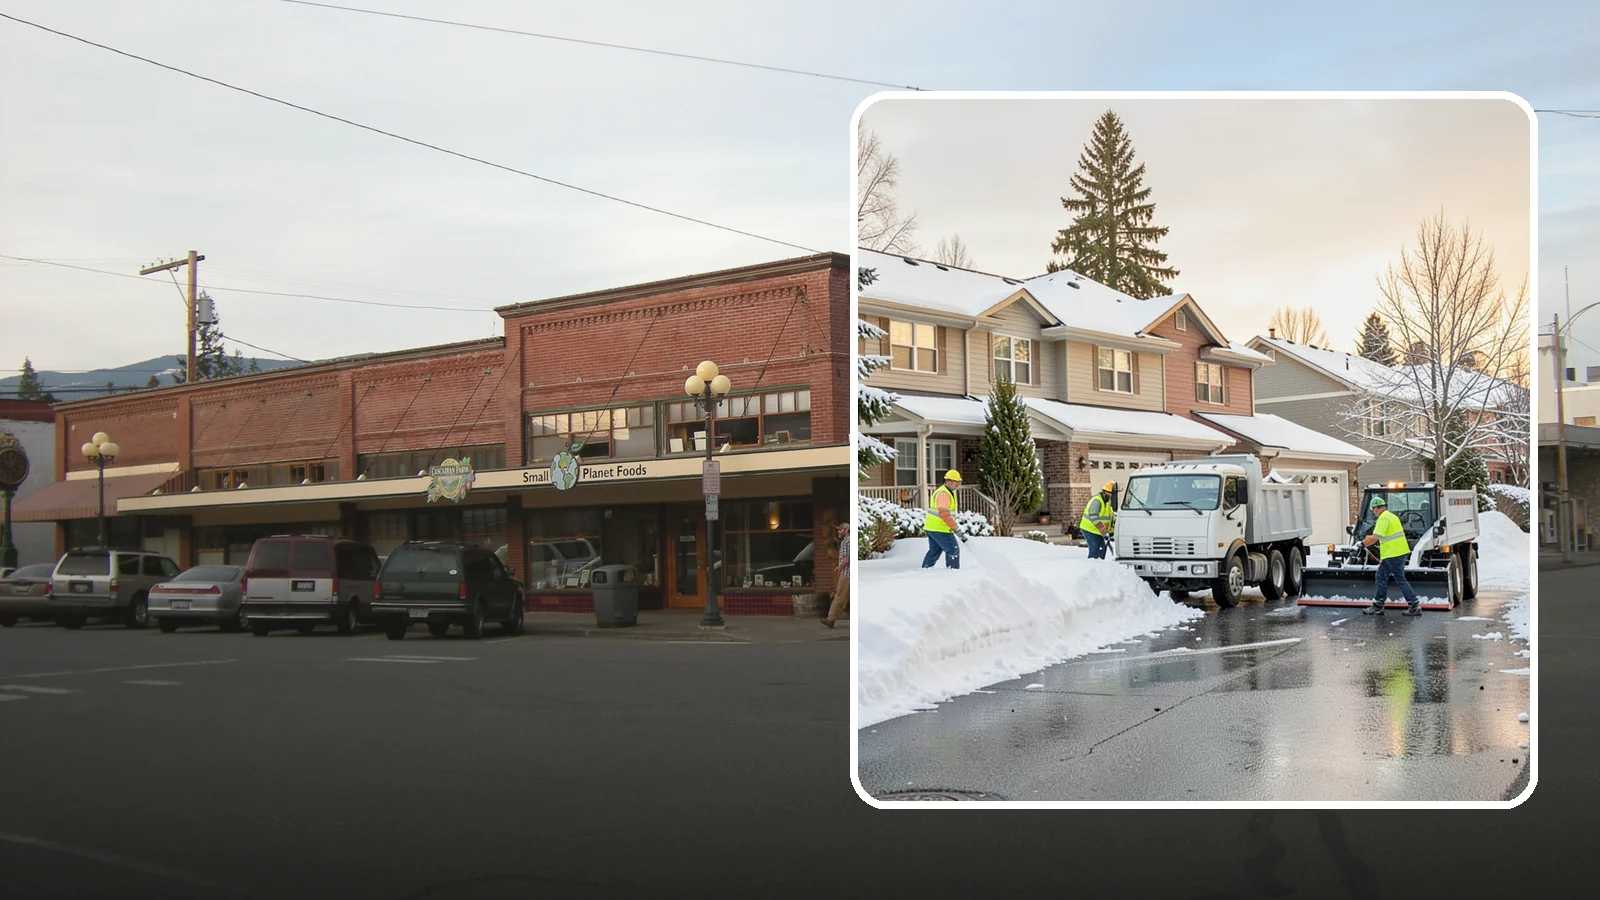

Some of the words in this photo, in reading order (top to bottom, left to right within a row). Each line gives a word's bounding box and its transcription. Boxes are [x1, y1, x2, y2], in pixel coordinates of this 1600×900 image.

[523, 471, 549, 483] Small
[582, 467, 614, 479] Planet
[616, 464, 647, 477] Foods
